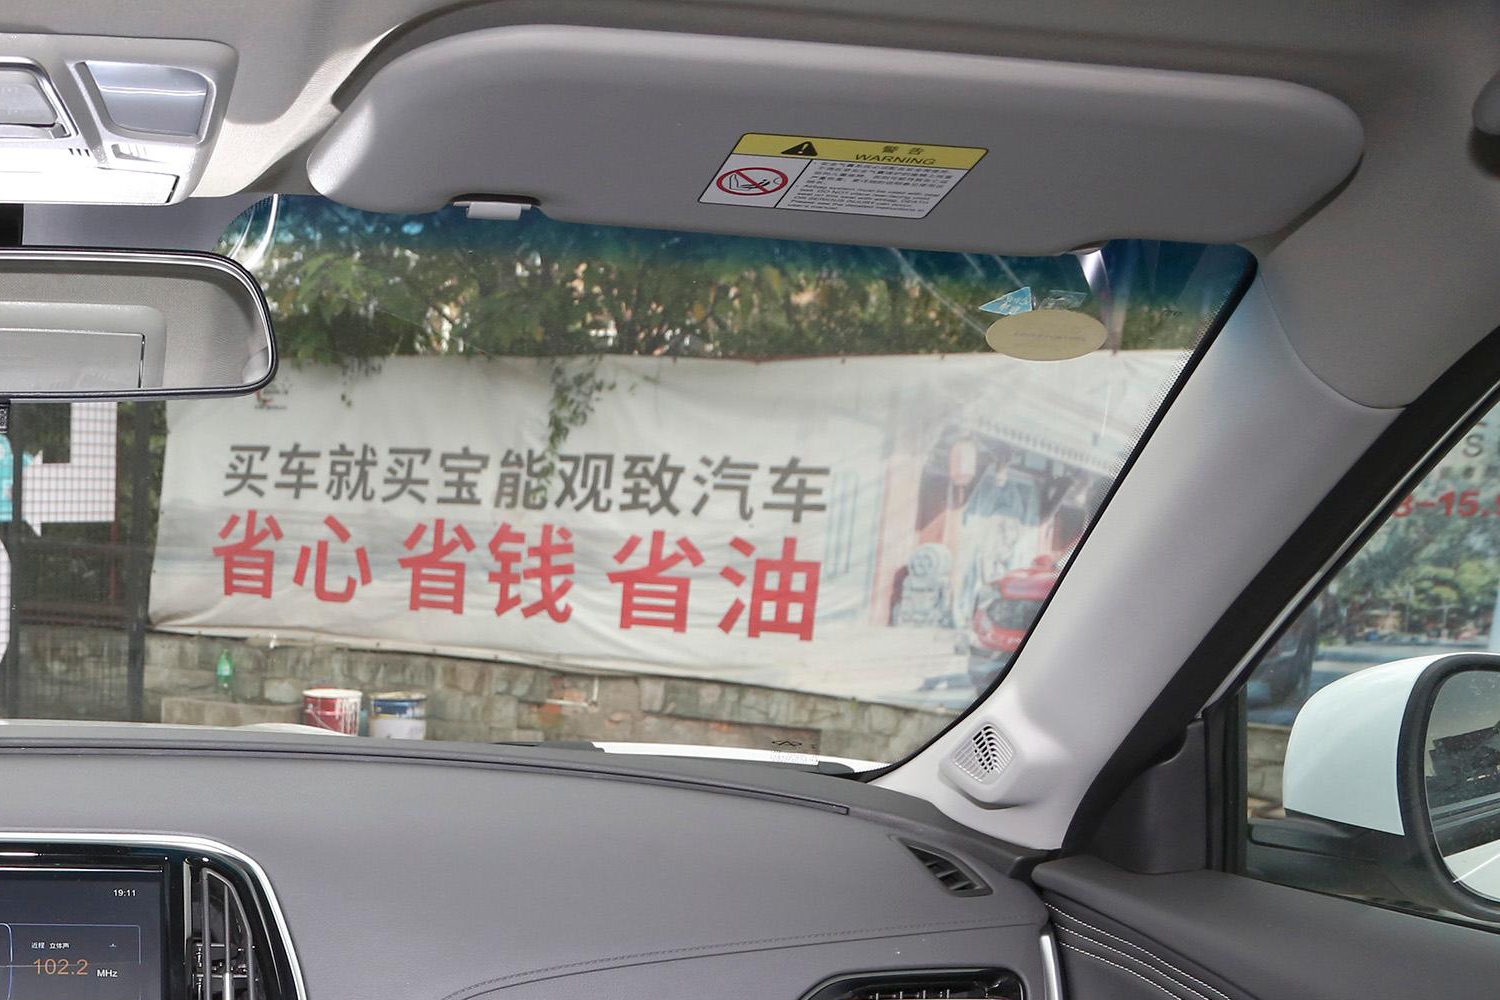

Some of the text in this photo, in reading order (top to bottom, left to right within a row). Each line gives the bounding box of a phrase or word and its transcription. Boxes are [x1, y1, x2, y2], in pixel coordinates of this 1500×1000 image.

[855, 154, 936, 165] WARNING
[223, 443, 831, 523] 买车就买宝能观致汽车
[212, 509, 821, 641] 省心 省钱 省油
[113, 889, 137, 897] 19:11
[34, 958, 118, 978] 102.2 MHz
